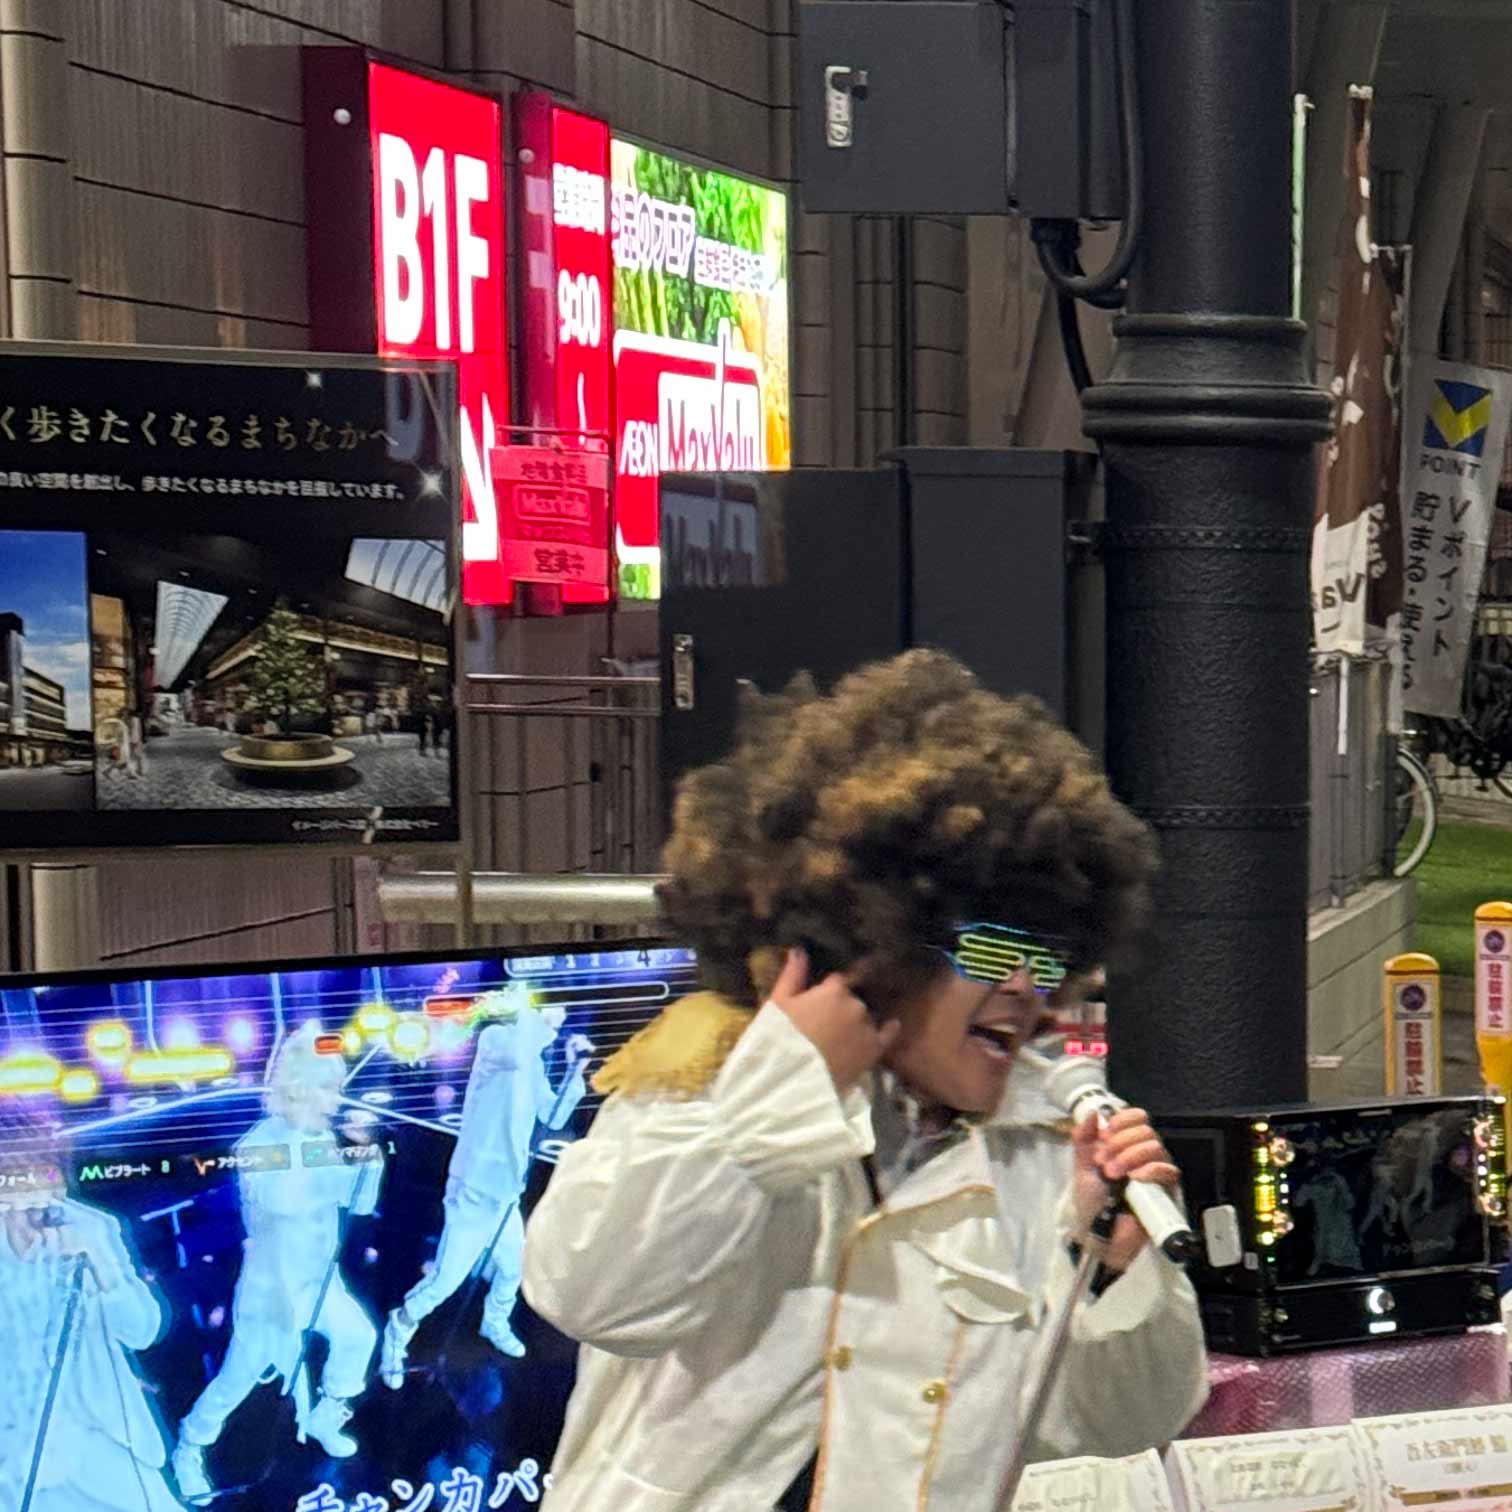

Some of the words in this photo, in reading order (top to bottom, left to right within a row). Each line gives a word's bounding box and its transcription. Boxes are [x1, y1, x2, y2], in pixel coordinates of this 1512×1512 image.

[379, 132, 490, 353] B1F
[557, 268, 601, 348] 9:00
[0, 404, 399, 450] く歩きたくなるまちなかへ
